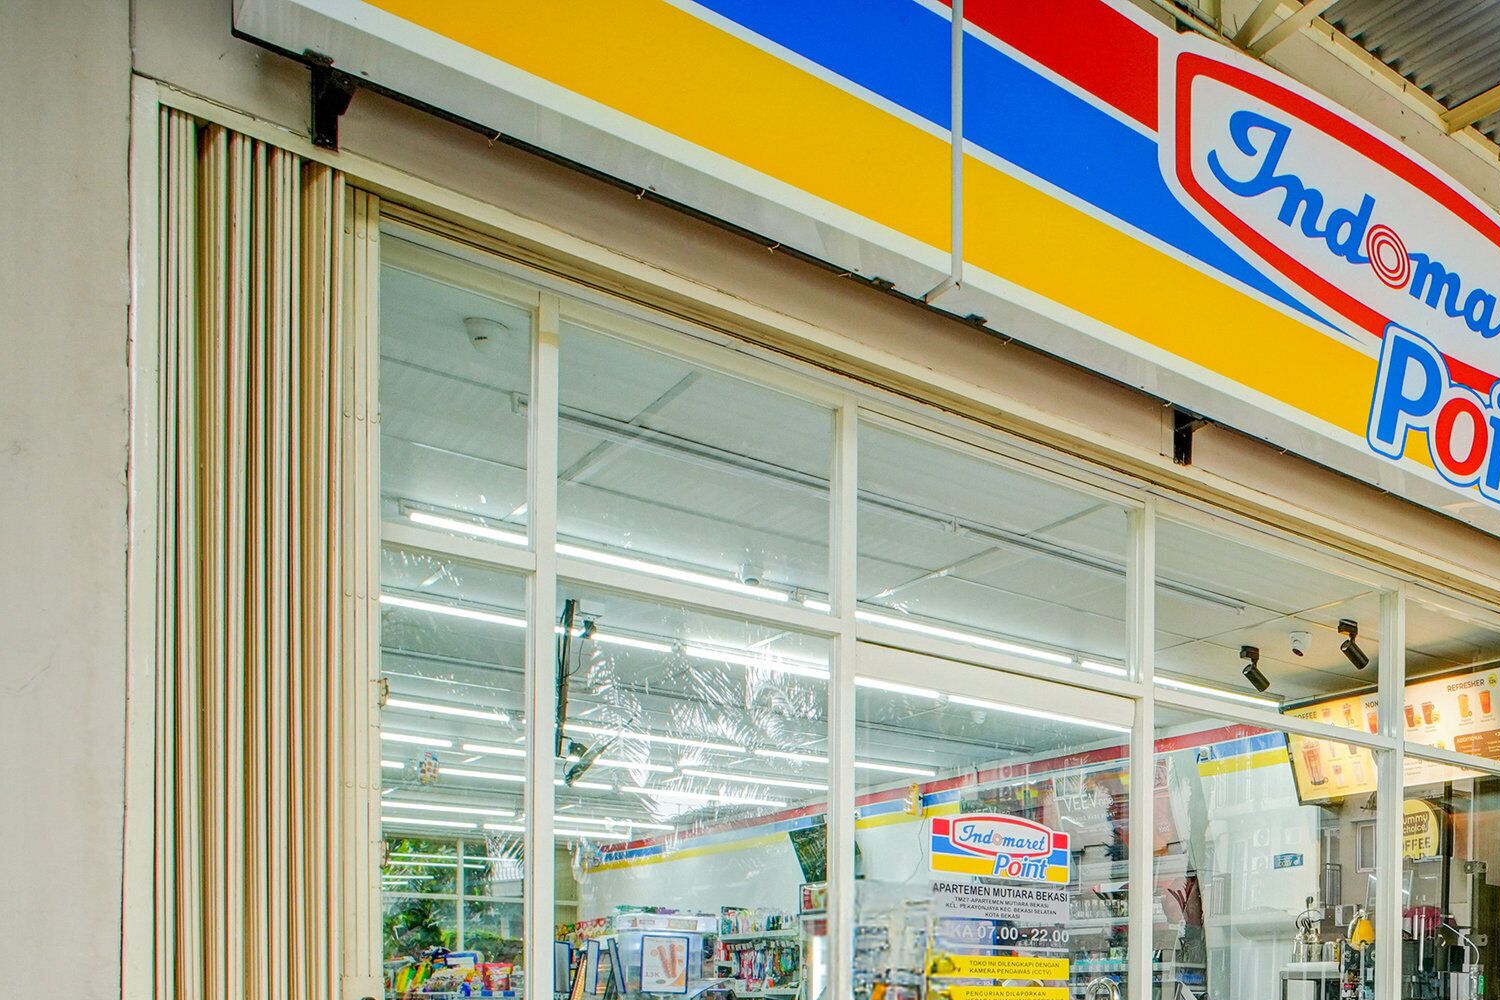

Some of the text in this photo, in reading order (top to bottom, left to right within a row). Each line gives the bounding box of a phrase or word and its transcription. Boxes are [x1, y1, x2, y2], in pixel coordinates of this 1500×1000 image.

[1447, 679, 1485, 692] REFRESHER
[1294, 711, 1318, 720] OFFEE
[958, 825, 1046, 852] Indomaret
[993, 854, 1048, 880] Point
[932, 882, 1068, 902] APARTEMEN MUTIARA BEKASI
[960, 904, 999, 912] PEKAYONJAYA
[1004, 900, 1029, 908] MUTIARA
[977, 925, 1019, 941] 07.00
[1030, 928, 1070, 943] 22.00
